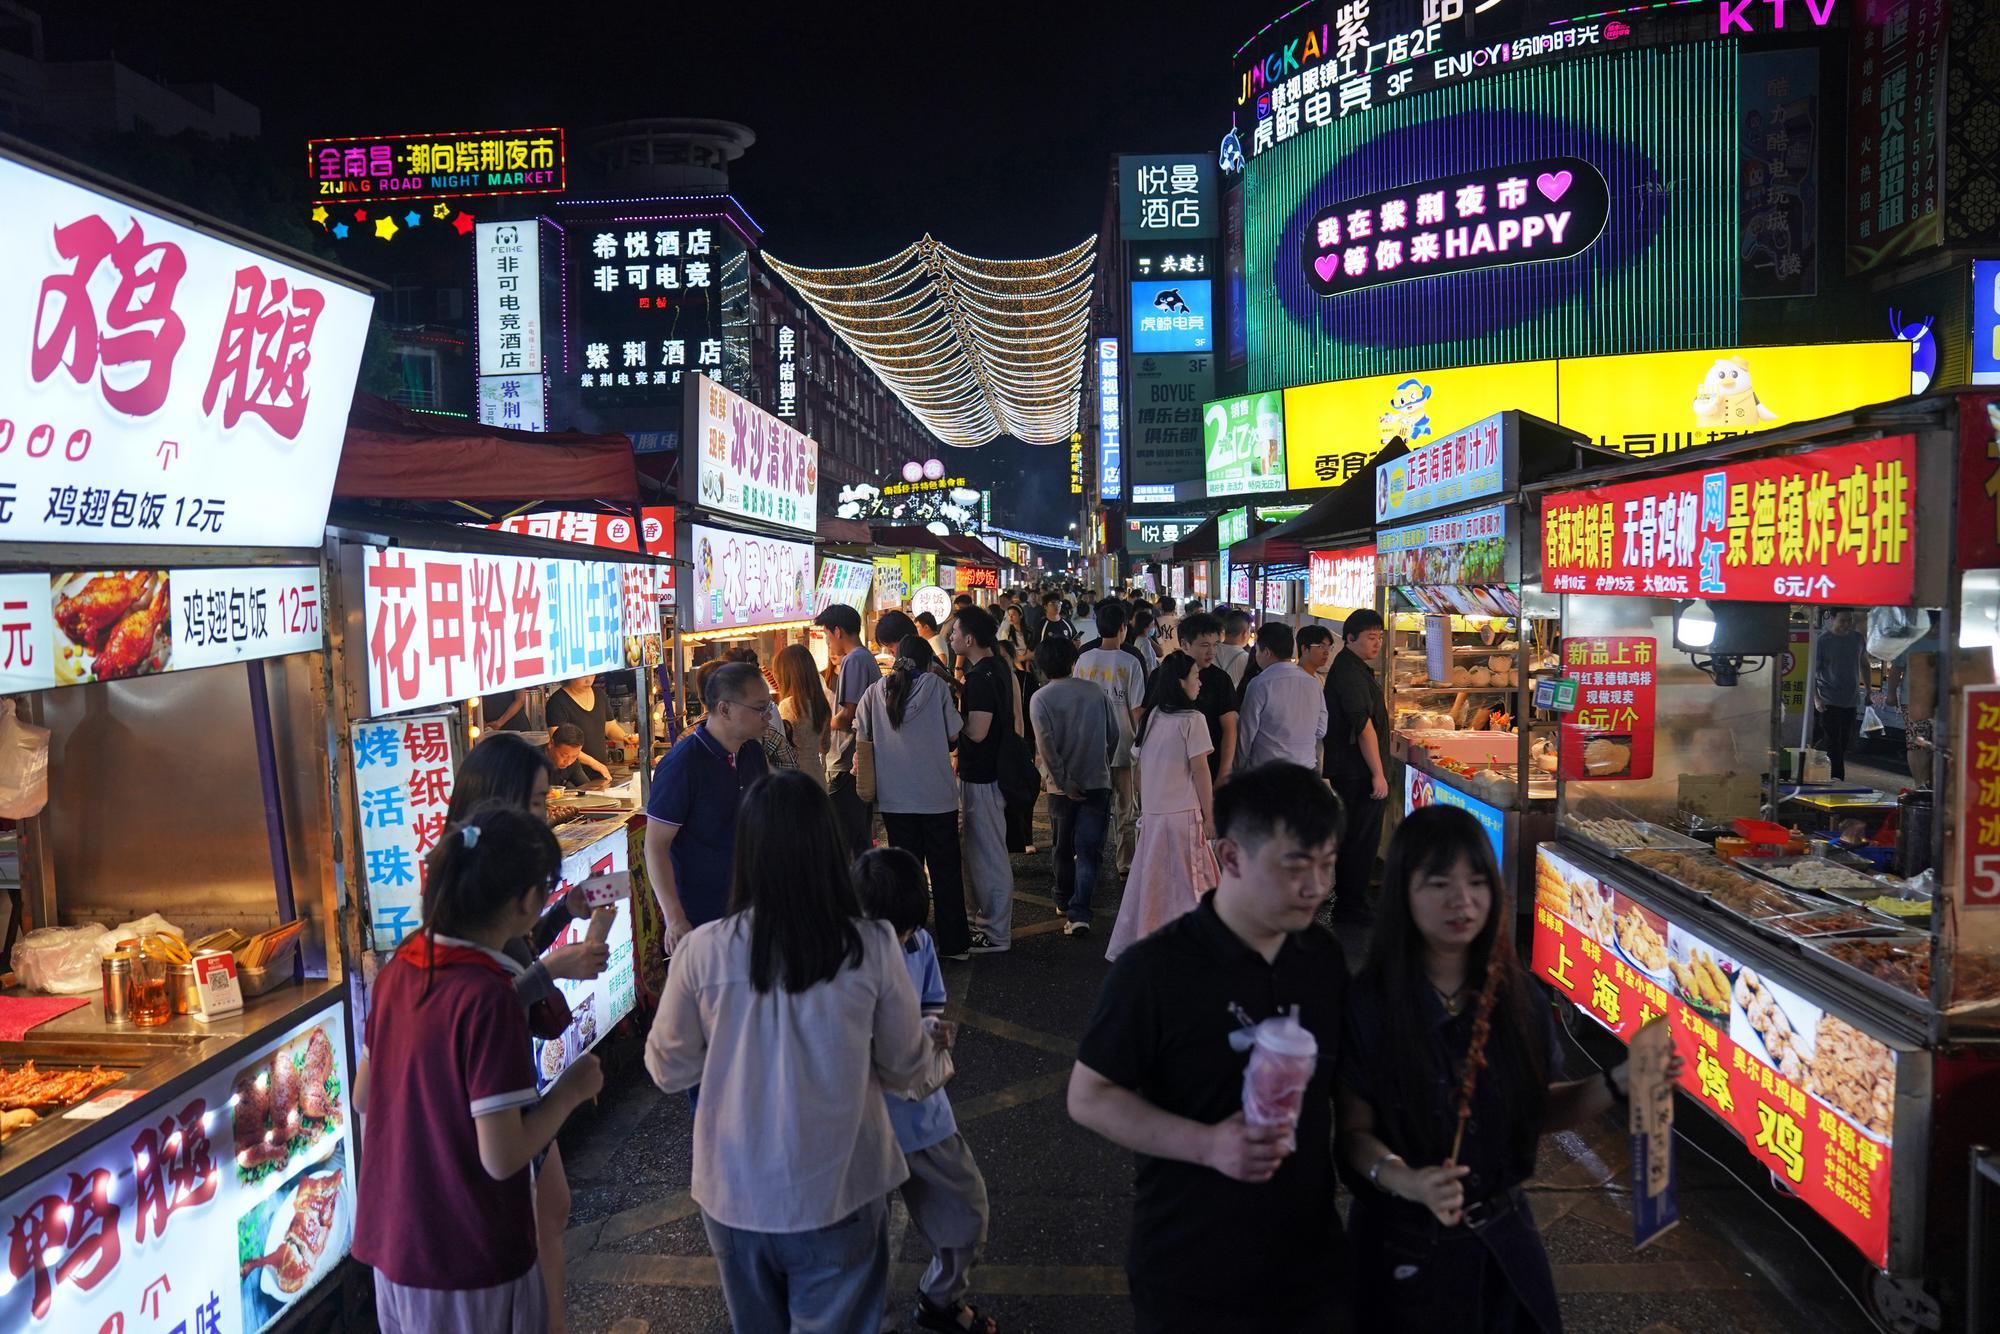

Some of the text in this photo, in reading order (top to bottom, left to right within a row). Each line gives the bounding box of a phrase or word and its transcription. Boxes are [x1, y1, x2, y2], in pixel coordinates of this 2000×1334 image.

[1720, 0, 1835, 33] KTV
[1512, 24, 1599, 60] 纷响时光
[1237, 24, 1328, 106] JINGKAI
[1253, 68, 1413, 157] 虎鲸电竞 3F
[318, 138, 554, 178] 全南昌·潮向紫荆夜市
[320, 170, 553, 194] ZIJING ROAD NIGHT MARKET
[1137, 164, 1199, 195] 悦曼
[1140, 197, 1200, 228] 酒店
[1317, 177, 1528, 248] 我在紫荆夜市
[593, 228, 711, 259] 希悦酒店
[594, 262, 711, 292] 非可电竞
[31, 214, 325, 440] 鸡腿
[497, 256, 522, 369] 非可电竞酒店
[1141, 316, 1204, 331] 虎鲸电竞
[586, 339, 722, 369] 紫荆酒店
[1195, 339, 1206, 347] 3F
[1189, 360, 1207, 373] 3F
[1151, 384, 1195, 402] BOYUE
[731, 399, 806, 497] 冰沙清补凉
[1145, 428, 1198, 444] 俱乐部
[1406, 421, 1499, 491] 正宗海南椰汁冰
[44, 485, 167, 530] 鸡翅包饭
[175, 497, 226, 533] 12元
[644, 522, 658, 538] 香
[1726, 459, 1909, 568] 景德镇炸鸡排
[612, 523, 624, 538] 色
[1546, 491, 1698, 570] 香辣鸡锁骨 无骨鸡柳
[1700, 471, 1727, 594] 网红
[1553, 574, 1689, 594] 小份10元 中份15元 大份20元
[1773, 574, 1836, 599] 6元/个
[2, 602, 33, 669] 元
[184, 585, 318, 647] 鸡翅包饭 12元
[368, 551, 545, 708] 花甲粉丝
[1567, 641, 1652, 666] 新品上市
[1570, 670, 1651, 686] 网红景德镇鸡排
[1586, 690, 1634, 705] 现做现卖
[1577, 707, 1640, 733] 6元/个
[354, 726, 419, 947] 烤活珠子
[1971, 854, 2000, 899] 5
[1580, 936, 1601, 964] 鸡排
[1614, 960, 1668, 1013] 黄金小鸡腿
[1679, 1006, 1719, 1052] 大鸡腿
[1732, 1046, 1807, 1120] 奥尔良鸡腿
[1817, 1107, 1884, 1172] 鸡锁骨
[1823, 1157, 1872, 1202] 中份15元
[1824, 1140, 1870, 1185] 小份10元
[1823, 1174, 1872, 1219] 大份20元
